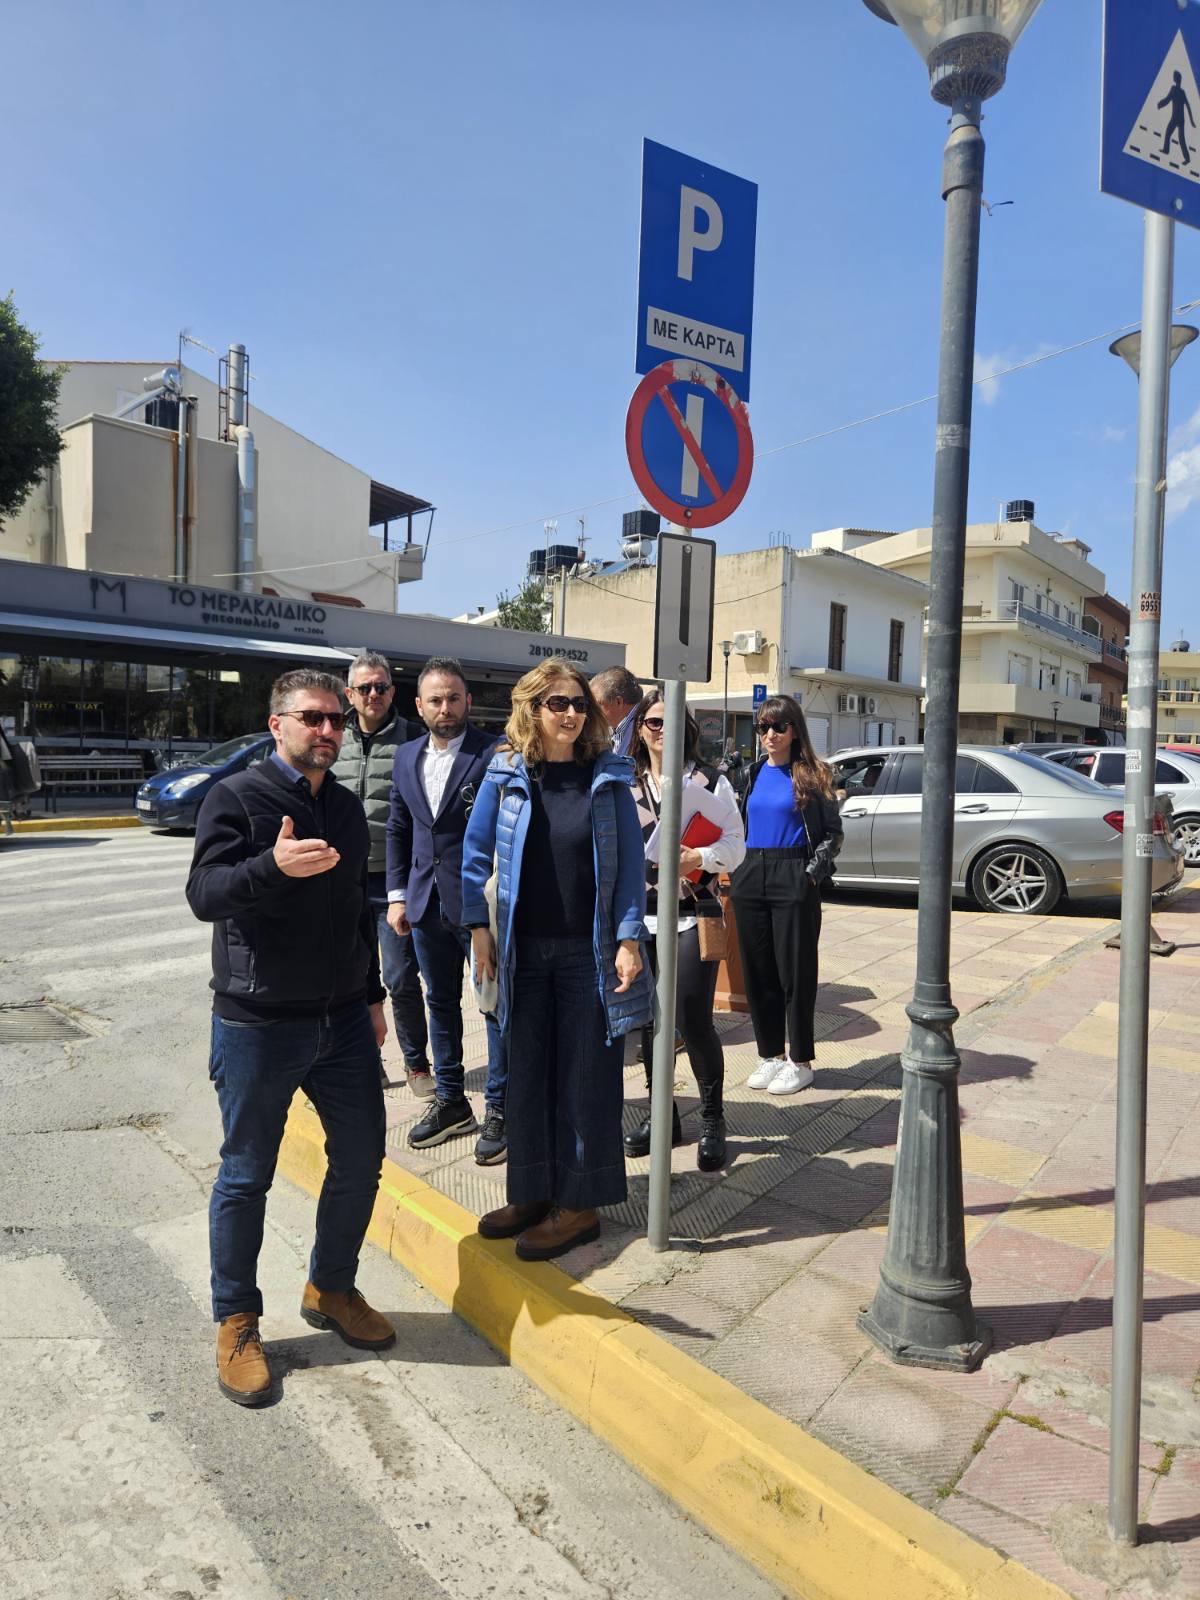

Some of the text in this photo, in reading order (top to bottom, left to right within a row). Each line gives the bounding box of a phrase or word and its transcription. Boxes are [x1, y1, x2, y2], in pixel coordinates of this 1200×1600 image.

[677, 184, 724, 282] P
[653, 317, 736, 358] ΜΕ ΚΑΡΤΑ
[168, 586, 327, 624] ΤΟ ΜΕΡΑΚΛΙΔΙΚΟ
[1141, 592, 1159, 600] ΚΛΕ
[1141, 600, 1160, 611] 6955
[529, 644, 553, 657] 2810
